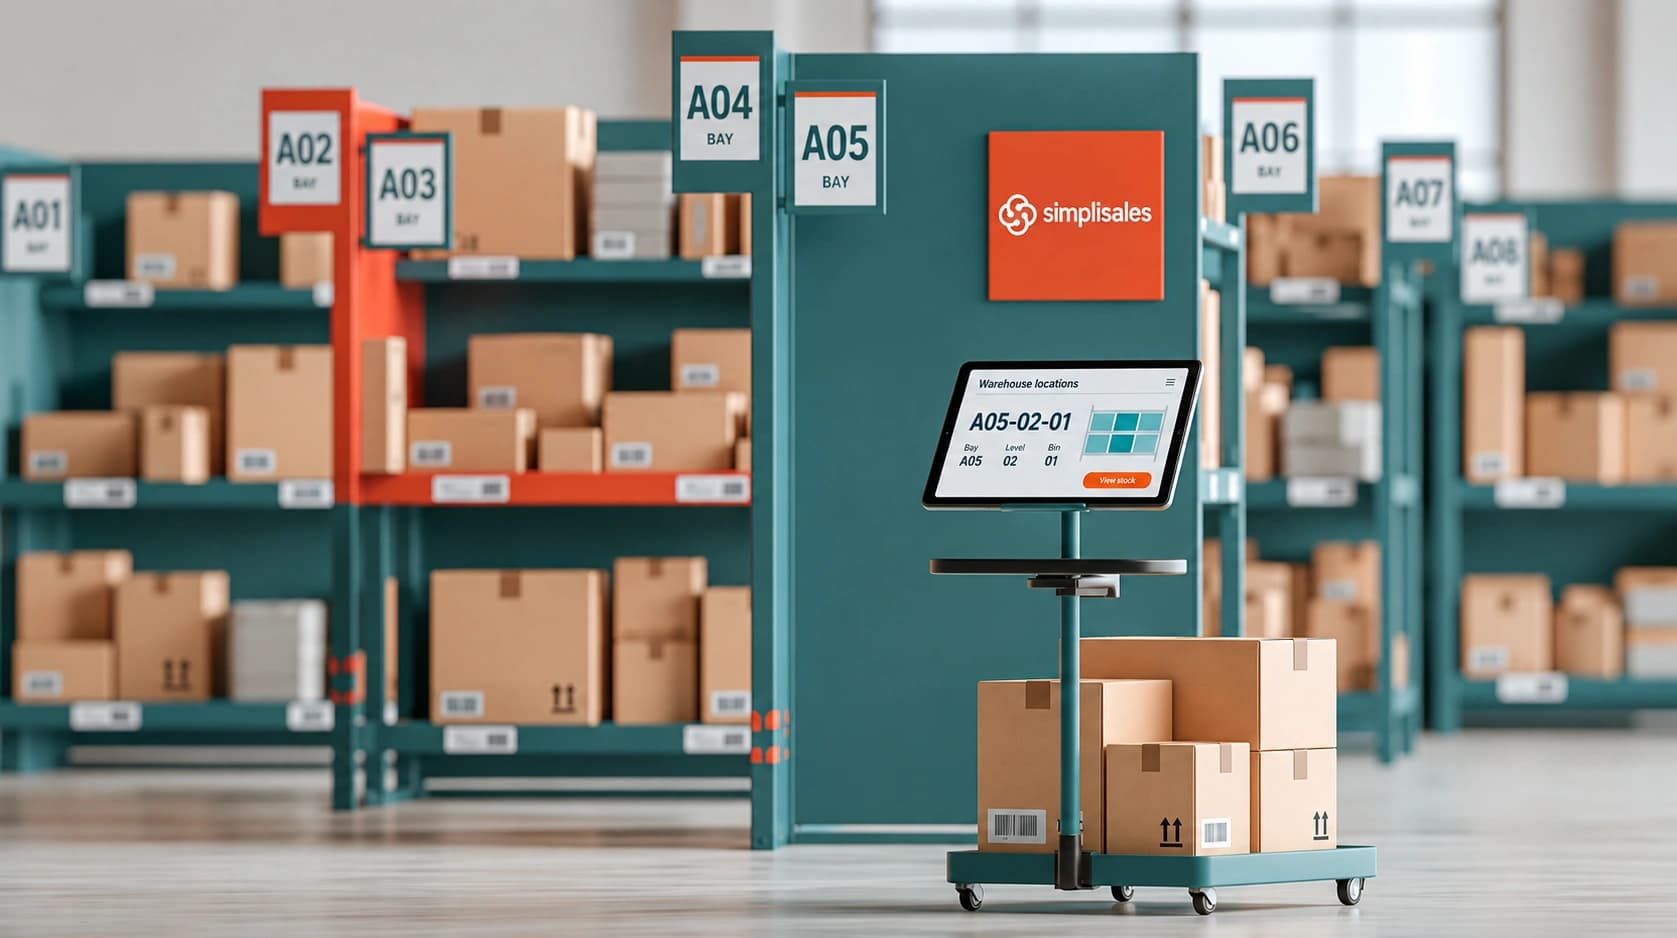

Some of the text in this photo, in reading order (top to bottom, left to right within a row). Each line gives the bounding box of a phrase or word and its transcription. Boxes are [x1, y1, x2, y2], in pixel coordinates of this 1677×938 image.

[686, 84, 753, 121] A04
[276, 132, 333, 165] A02
[706, 132, 734, 146] BAY
[801, 124, 870, 162] A05
[1240, 121, 1300, 153] A06
[379, 167, 436, 200] A03
[821, 175, 850, 189] BAY
[1394, 179, 1444, 207] A07
[11, 200, 62, 231] A01
[1042, 200, 1153, 229] simplisales
[979, 379, 1079, 389] Warehouse locations
[969, 412, 1072, 432] A05-02-01
[959, 455, 1058, 467] A05 02 01
[963, 443, 1061, 453] Bay Level Bin
[1099, 476, 1136, 485] View stock
